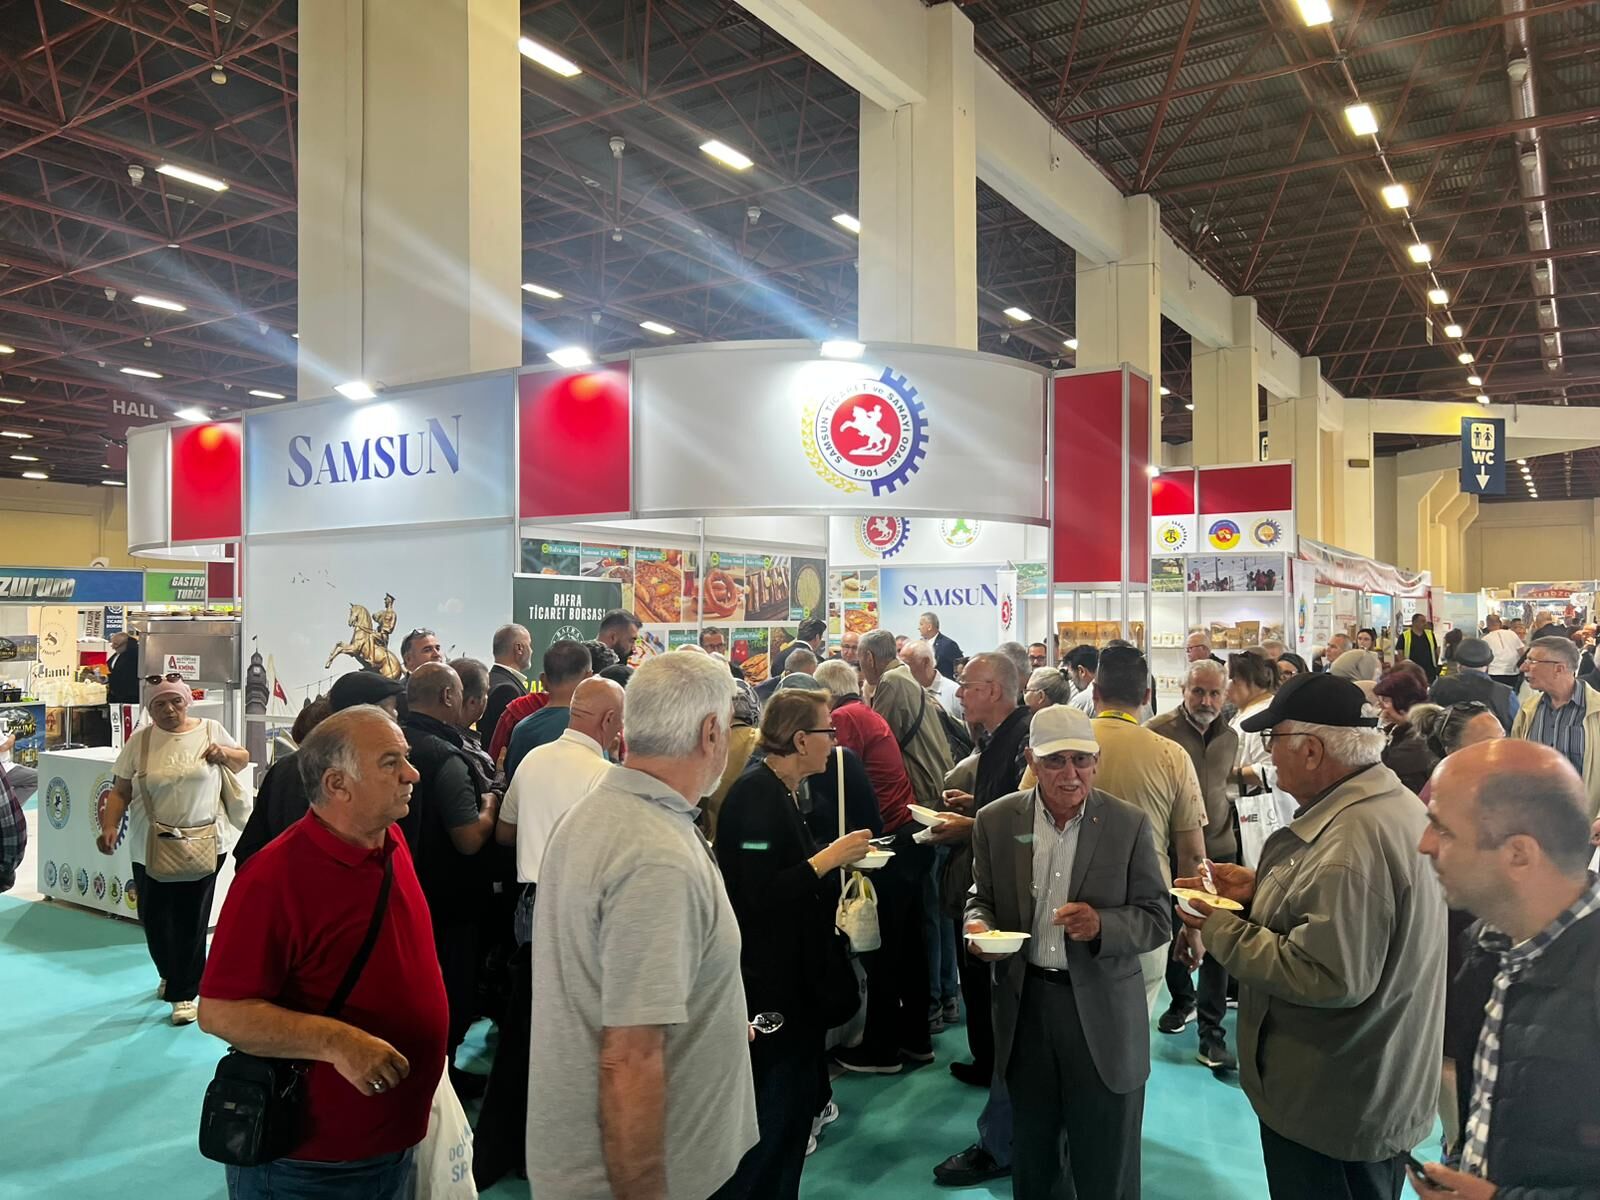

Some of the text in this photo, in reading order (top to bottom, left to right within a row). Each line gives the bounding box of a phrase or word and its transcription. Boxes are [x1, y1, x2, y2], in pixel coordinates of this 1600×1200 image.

[112, 399, 159, 419] HALL
[820, 416, 843, 464] SAMSUN
[886, 436, 909, 467] ODASI
[287, 414, 462, 488] SAMSUN
[1471, 450, 1495, 465] WC
[853, 468, 879, 477] 1901
[172, 576, 206, 586] GASTRO
[553, 593, 582, 607] BAFRA
[529, 604, 566, 620] TİCARET
